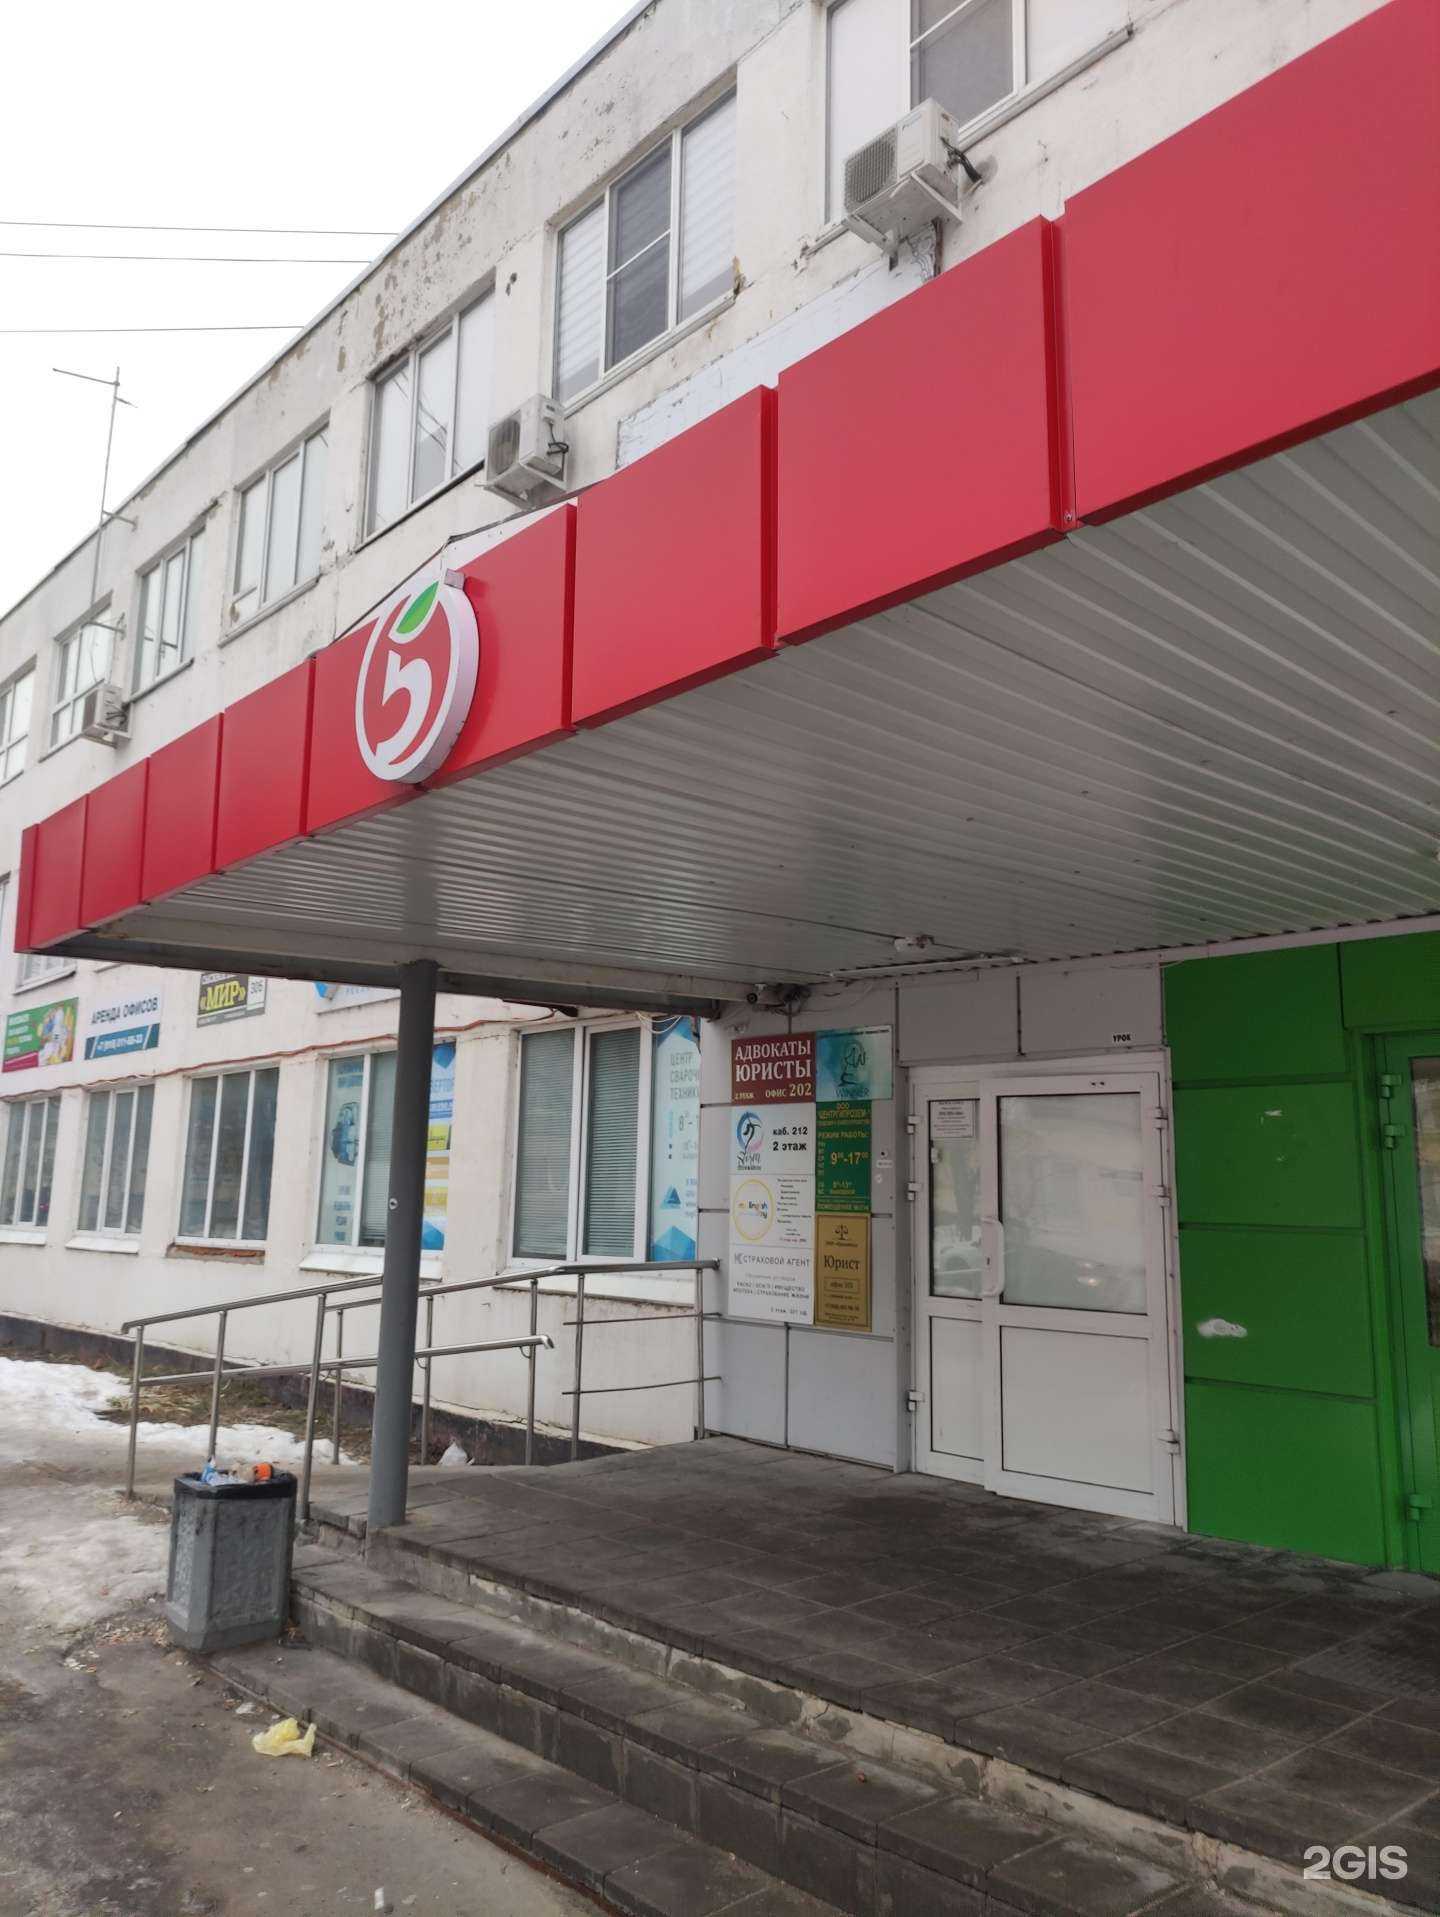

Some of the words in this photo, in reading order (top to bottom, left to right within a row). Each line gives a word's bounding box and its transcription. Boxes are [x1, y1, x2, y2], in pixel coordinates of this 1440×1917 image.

[91, 1006, 121, 1024] АРЕНДА
[122, 997, 158, 1018] ОФИСОВ
[735, 1039, 811, 1062] АДВОКАТЫ
[735, 1060, 812, 1082] ЮРИСТЫ
[765, 1088, 787, 1098] ОФИС
[789, 1083, 812, 1096] 202
[772, 1126, 790, 1136] каб.
[792, 1126, 808, 1135] 212
[772, 1141, 779, 1151] 2
[782, 1142, 807, 1151] этаж
[743, 1254, 785, 1265] СТРАХОВОЙ
[786, 1256, 810, 1267] АГЕНТ
[823, 1255, 860, 1271] Юрист
